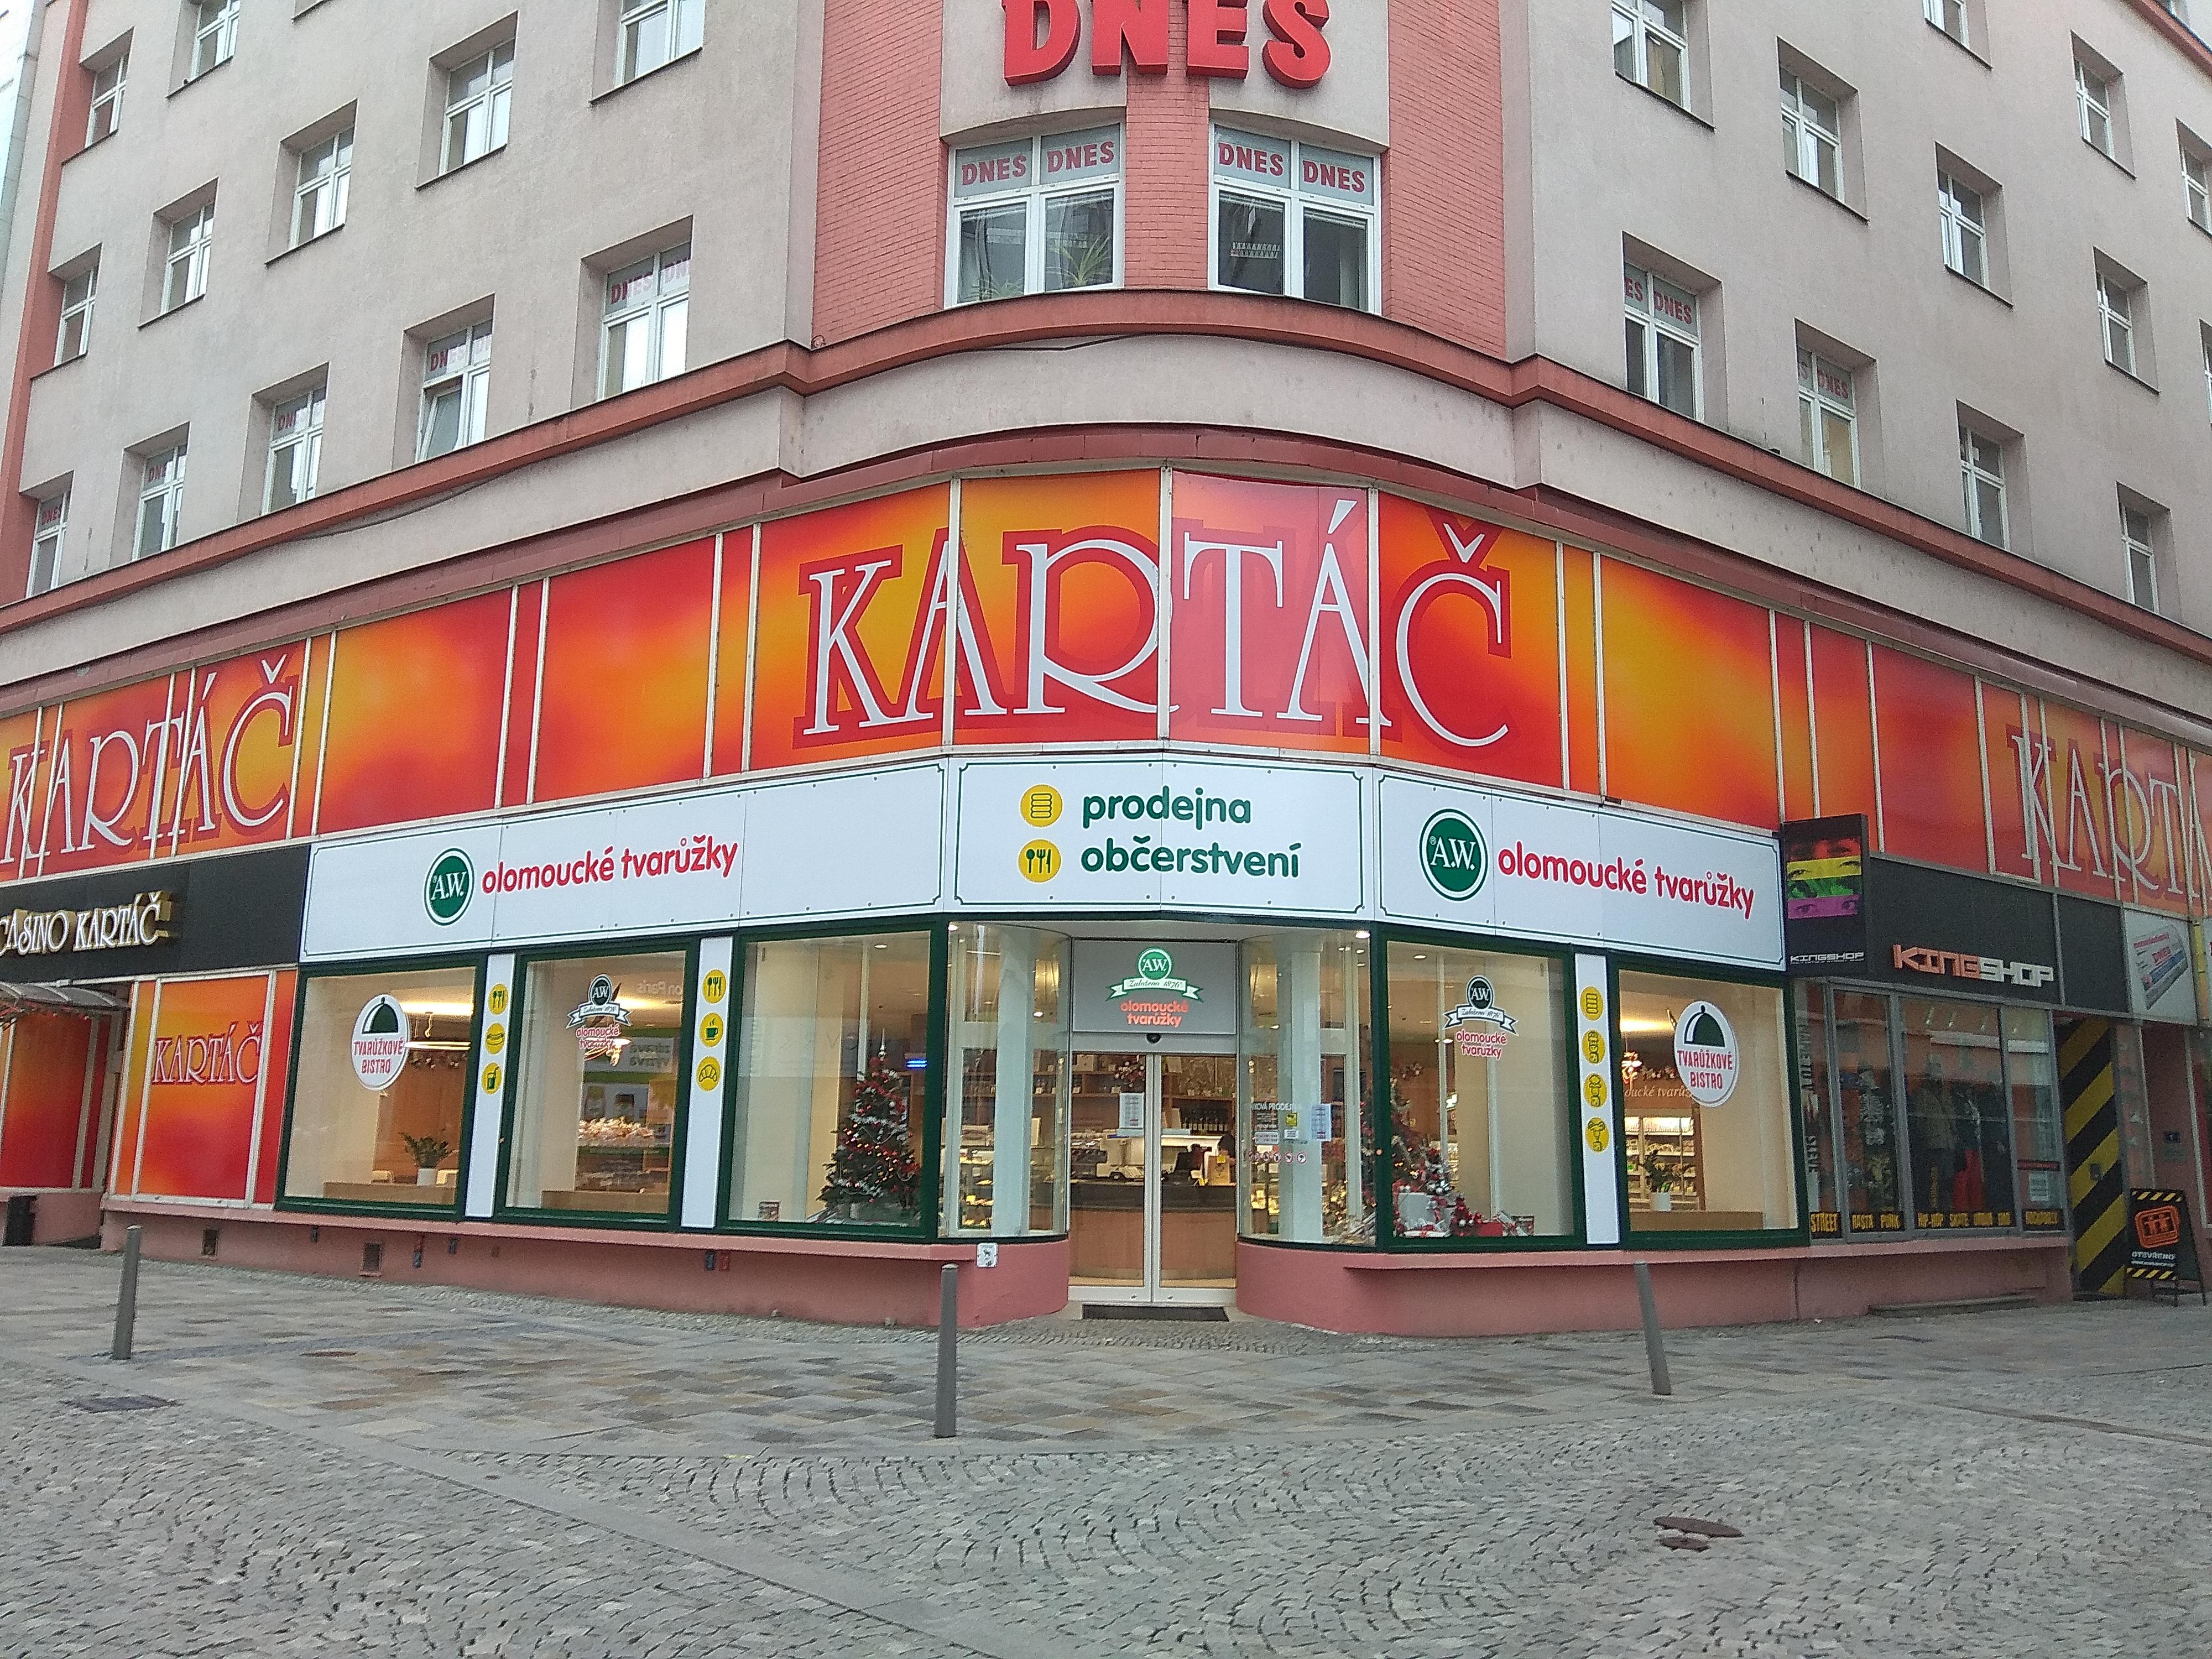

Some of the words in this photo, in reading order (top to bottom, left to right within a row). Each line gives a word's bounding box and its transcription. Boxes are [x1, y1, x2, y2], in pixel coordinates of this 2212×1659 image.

[1003, 0, 1330, 88] DNES
[961, 155, 1027, 186] DNES
[1047, 141, 1114, 173] DNES
[1219, 142, 1284, 176] DNES
[1302, 159, 1365, 193] DNES
[1625, 276, 1643, 302] ES
[1654, 291, 1692, 325] DNES
[803, 499, 1509, 747] KARTÁČ
[0, 654, 293, 864] KARTÁČ
[1082, 785, 1252, 831] prodejna
[2012, 735, 2212, 899] KARTÁ
[482, 846, 614, 894] olomoucké
[622, 834, 738, 879] tvarůžky
[1081, 834, 1303, 879] občerstvení
[1498, 841, 1647, 894] olomoucké
[1655, 865, 1755, 919] tvarůžky
[74, 891, 163, 951] KARTÁČ
[1790, 951, 1865, 962] KINGSHOP
[1892, 943, 2054, 988] KINGSHOP
[1121, 1000, 1188, 1013] olomoucké
[152, 1021, 262, 1084] KARTÁČ
[354, 1036, 404, 1056] TVARŮŽKOVÉ
[576, 1024, 620, 1037] olomoucké
[1457, 1030, 1507, 1045] olomoucké
[361, 1058, 391, 1074] BISTRO
[1677, 1048, 1733, 1070] TVARŮŽKOVÉ
[1689, 1071, 1723, 1090] BISTRO
[1811, 1213, 1838, 1233] STREET
